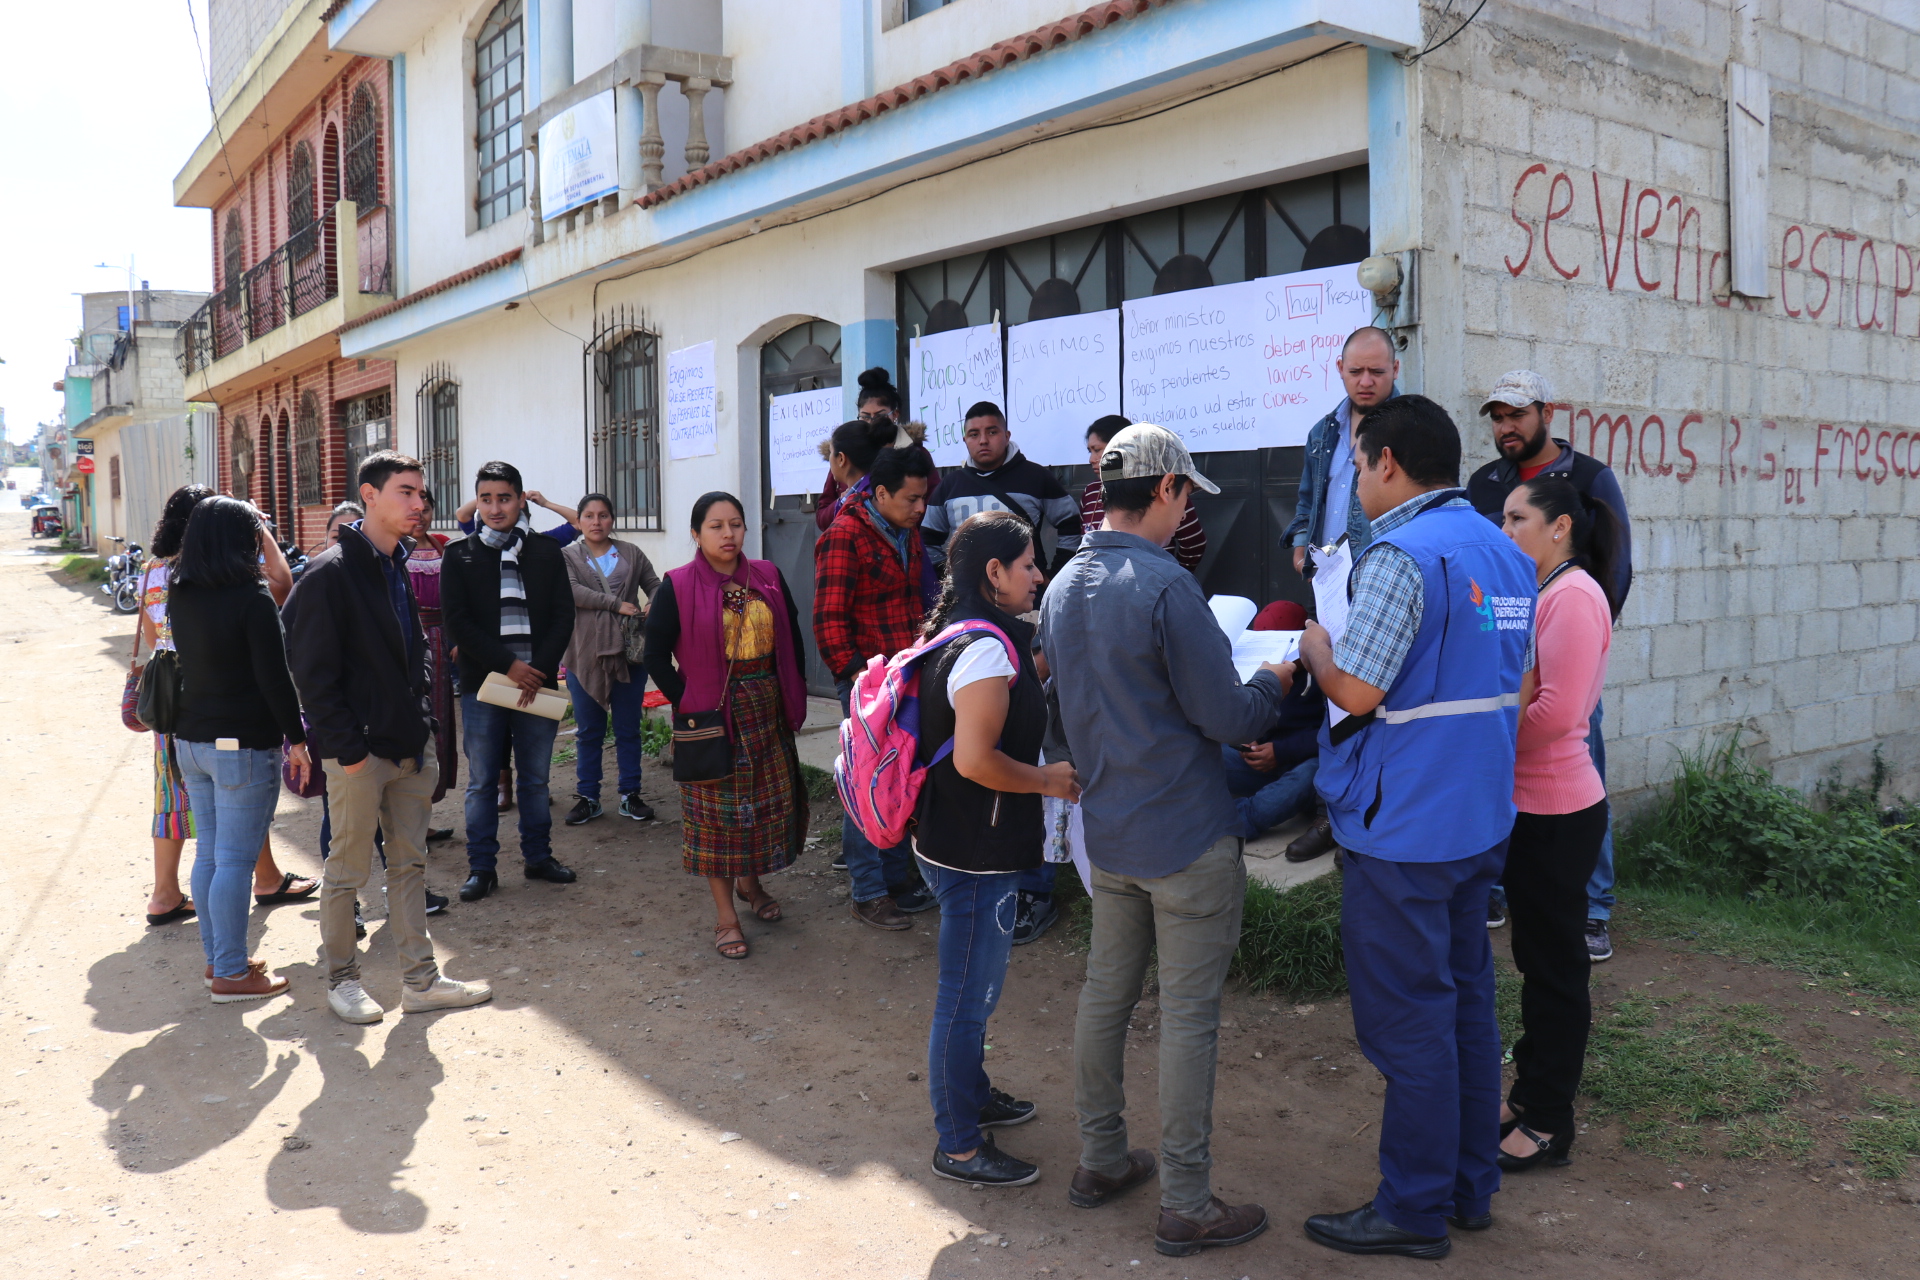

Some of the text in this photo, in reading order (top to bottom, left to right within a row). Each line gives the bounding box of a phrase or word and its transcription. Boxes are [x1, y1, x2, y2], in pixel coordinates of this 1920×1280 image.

[1265, 279, 1371, 324] Si hay Presup
[1165, 305, 1226, 330] ministro
[1012, 333, 1105, 364] EXIGIMOS
[1131, 329, 1255, 374] exigimos nuestros
[1264, 333, 1345, 363] deben pagar
[669, 365, 704, 388] Exigimos
[920, 350, 967, 411] Pagos
[1131, 364, 1231, 406] Pagos pendientes
[1267, 364, 1312, 385] larios
[701, 404, 711, 418] DE
[1014, 375, 1107, 423] Contratos
[1190, 406, 1198, 419] a
[1227, 392, 1257, 411] estar
[797, 427, 802, 440] el
[805, 425, 829, 446] proceso
[919, 396, 966, 453] Efect
[1190, 426, 1208, 438] sin
[1212, 415, 1256, 434] sueldo?
[1495, 606, 1530, 618] DERECHOS
[1496, 619, 1528, 631] HUMANOS
